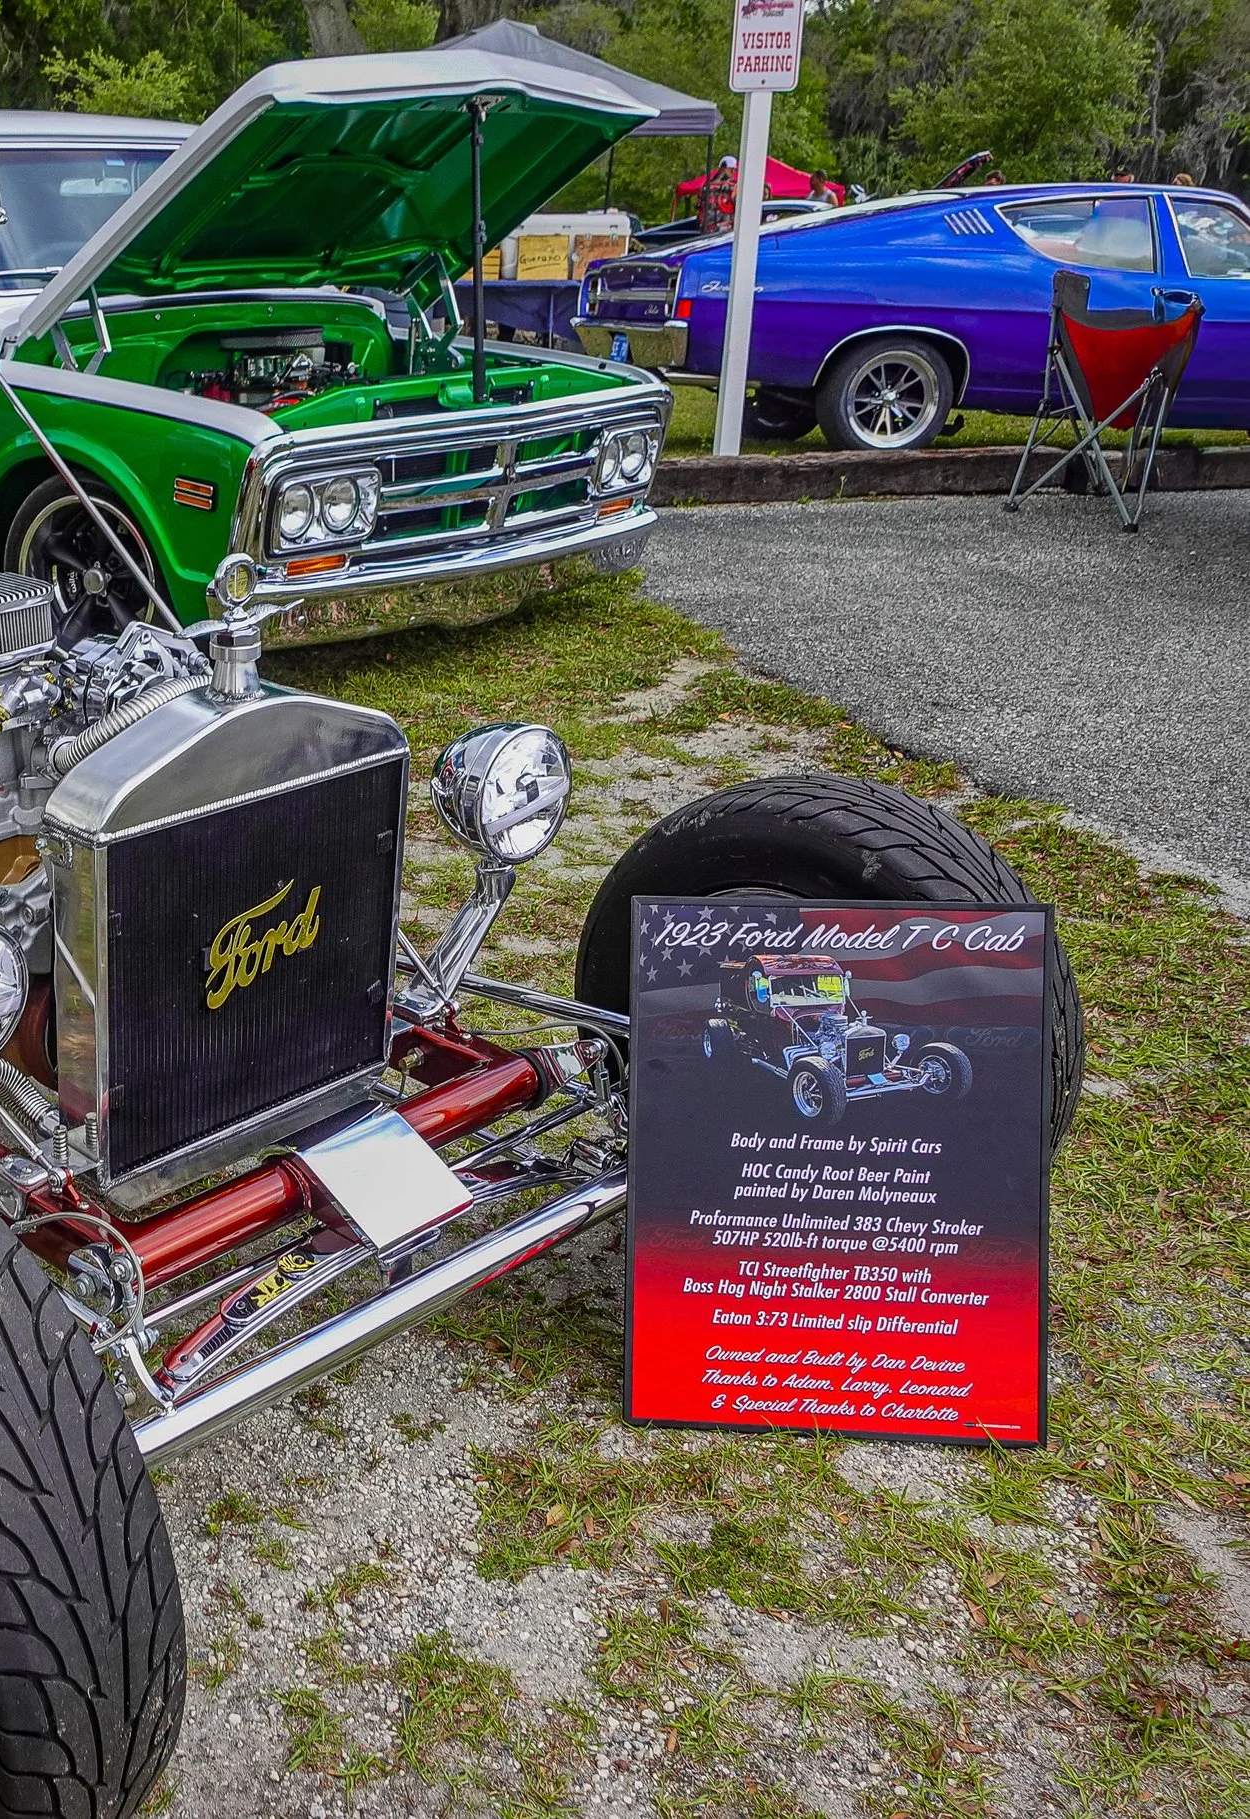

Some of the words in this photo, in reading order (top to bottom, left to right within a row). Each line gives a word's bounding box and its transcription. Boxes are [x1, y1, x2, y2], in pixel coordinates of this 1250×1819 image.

[742, 32, 791, 49] VISITOR
[736, 55, 793, 73] PARKING
[205, 878, 322, 1009] Ford
[654, 921, 729, 947] 1923
[728, 922, 804, 948] Ford
[801, 923, 900, 950] Model
[901, 925, 930, 949] T
[931, 924, 959, 951] C
[964, 925, 1026, 952] Cab
[730, 1131, 766, 1152] Body
[769, 1133, 798, 1149] and
[799, 1134, 844, 1151] Frame
[848, 1134, 867, 1155] by
[869, 1136, 908, 1156] Spirit
[911, 1138, 942, 1154] Cars
[741, 1162, 773, 1179] HOC
[775, 1163, 819, 1183] Candy
[822, 1165, 854, 1181] Root
[857, 1166, 891, 1183] Beer
[893, 1168, 931, 1184] Paint
[733, 1182, 789, 1200] painted
[790, 1182, 809, 1203] by
[812, 1184, 855, 1201] Daren
[858, 1185, 938, 1206] Molyneaux
[690, 1209, 778, 1228] Proformance
[782, 1212, 850, 1231] Unlimited
[853, 1215, 882, 1232] 383
[885, 1217, 929, 1237] Chevy
[931, 1219, 984, 1236] Stroker
[712, 1230, 760, 1246] 507HP
[762, 1231, 819, 1249] 520lb-ft
[821, 1236, 868, 1253] torque
[871, 1236, 926, 1253] @5400
[929, 1242, 959, 1257] rpm
[738, 1260, 760, 1277] TCI
[763, 1261, 850, 1283] Streetfighter
[853, 1265, 898, 1282] TB350
[902, 1267, 932, 1284] with
[683, 1277, 714, 1294] Boss
[717, 1279, 746, 1298] Hog
[749, 1280, 788, 1299] Night
[790, 1282, 840, 1299] Stalker
[843, 1284, 882, 1301] 2800
[885, 1286, 918, 1303] Stall
[920, 1288, 990, 1306] Converter
[712, 1308, 752, 1325] Eaton
[755, 1311, 789, 1327] 3:73
[791, 1312, 845, 1330] Limited
[847, 1314, 872, 1335] slip
[876, 1316, 959, 1335] Differential
[705, 1345, 766, 1363] Owned
[765, 1349, 803, 1364] and
[802, 1350, 845, 1367] Built
[845, 1352, 867, 1375] by
[871, 1353, 907, 1370] Dan
[910, 1355, 966, 1373] Devine
[701, 1369, 759, 1387] Thanks
[762, 1373, 778, 1387] to
[899, 1380, 974, 1398] Leonard
[711, 1393, 727, 1409] &
[731, 1395, 798, 1414] Special
[798, 1398, 857, 1416] Thanks
[859, 1402, 877, 1417] to
[881, 1402, 959, 1421] Charlotte
